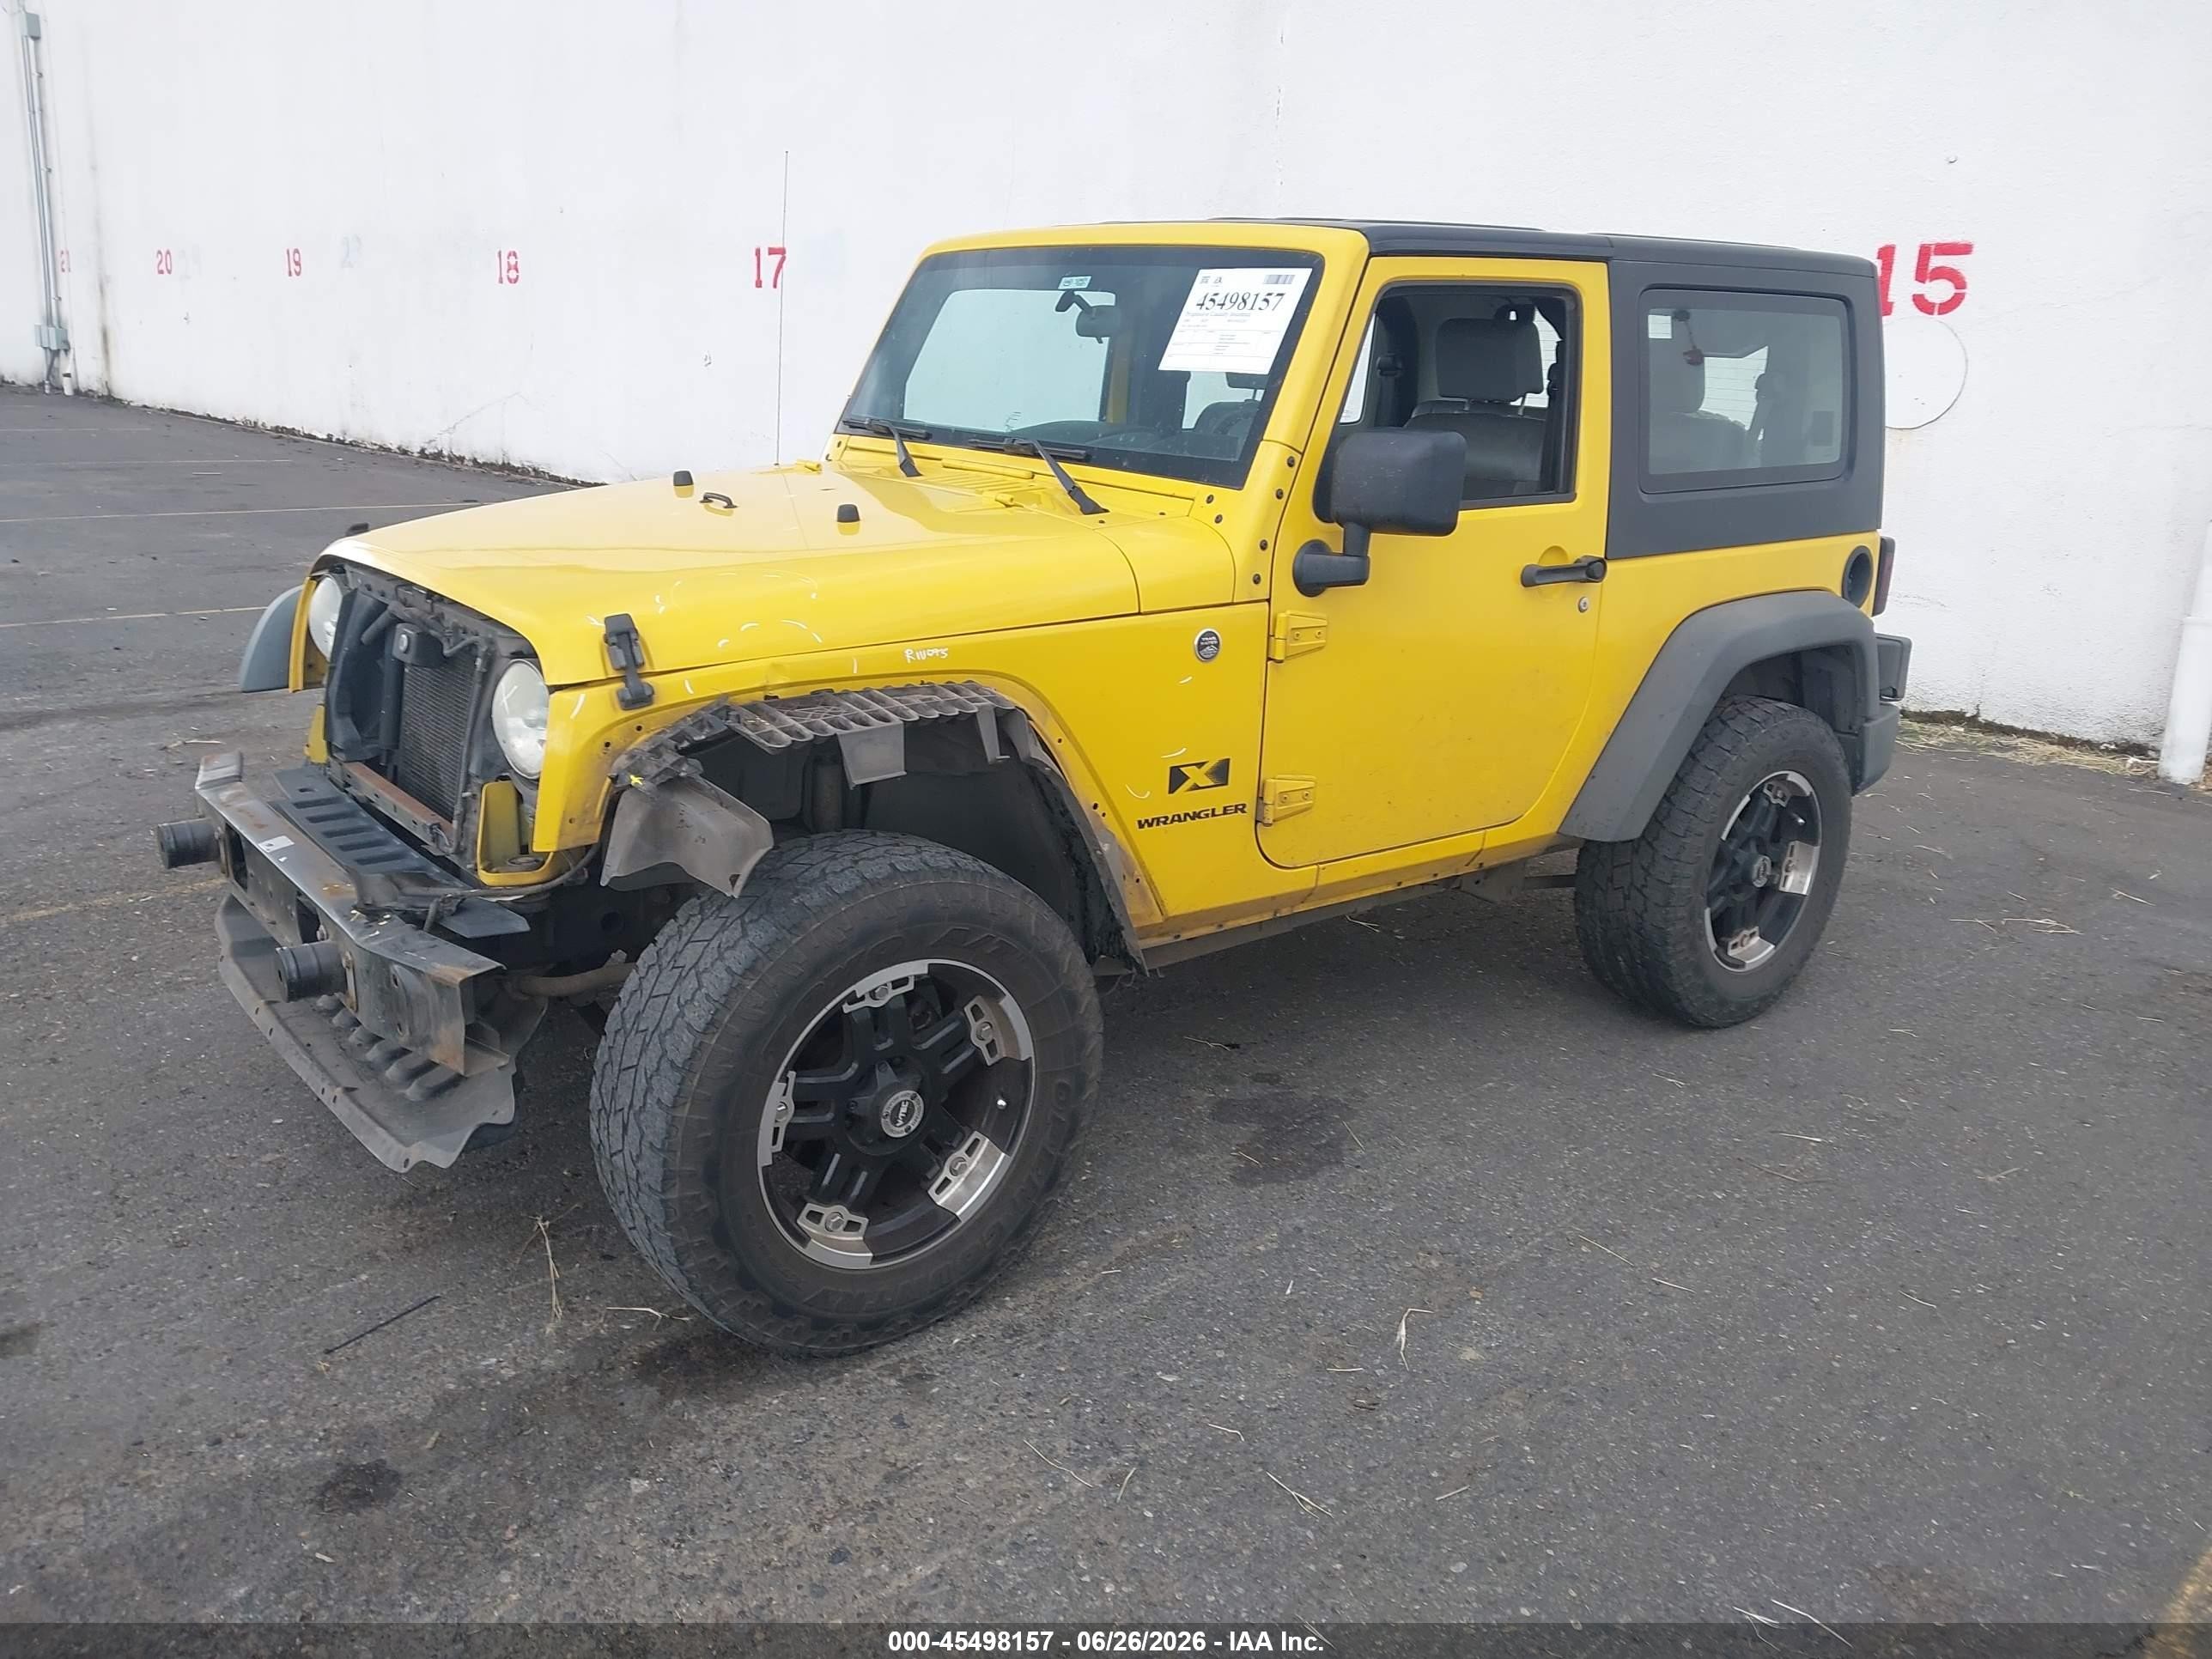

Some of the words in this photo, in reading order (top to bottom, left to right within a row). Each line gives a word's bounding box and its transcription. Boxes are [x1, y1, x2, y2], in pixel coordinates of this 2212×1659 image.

[156, 249, 173, 275] 20
[286, 248, 301, 276] 19
[497, 250, 520, 284] 18
[755, 246, 787, 289] 17
[1876, 241, 1976, 317] 15
[1196, 292, 1285, 311] 45498157
[1137, 803, 1248, 830] WRANGLER
